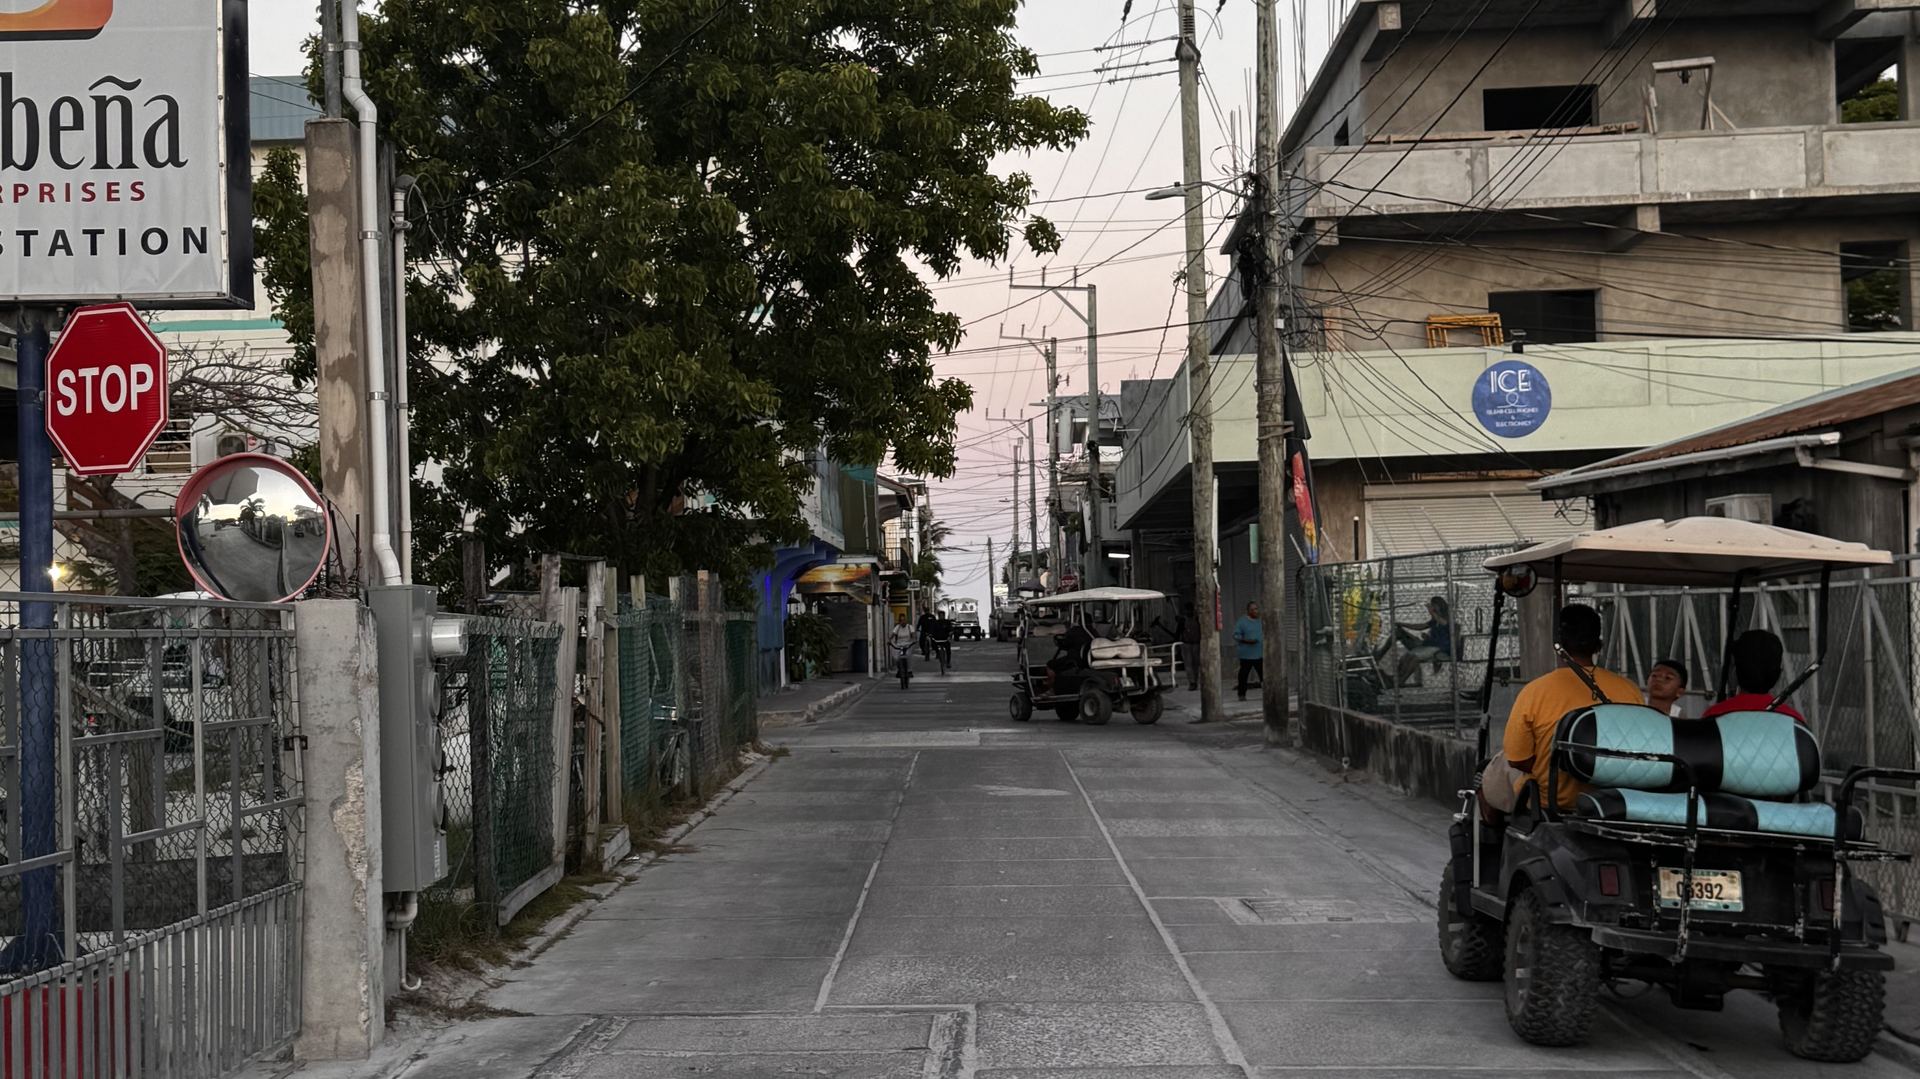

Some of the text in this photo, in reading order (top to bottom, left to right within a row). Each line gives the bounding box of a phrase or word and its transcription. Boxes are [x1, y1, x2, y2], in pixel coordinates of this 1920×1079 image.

[0, 72, 189, 171] beña
[0, 181, 146, 203] PRISES
[0, 226, 207, 257] TATION
[57, 363, 154, 416] STOP
[1490, 369, 1532, 393] ICE
